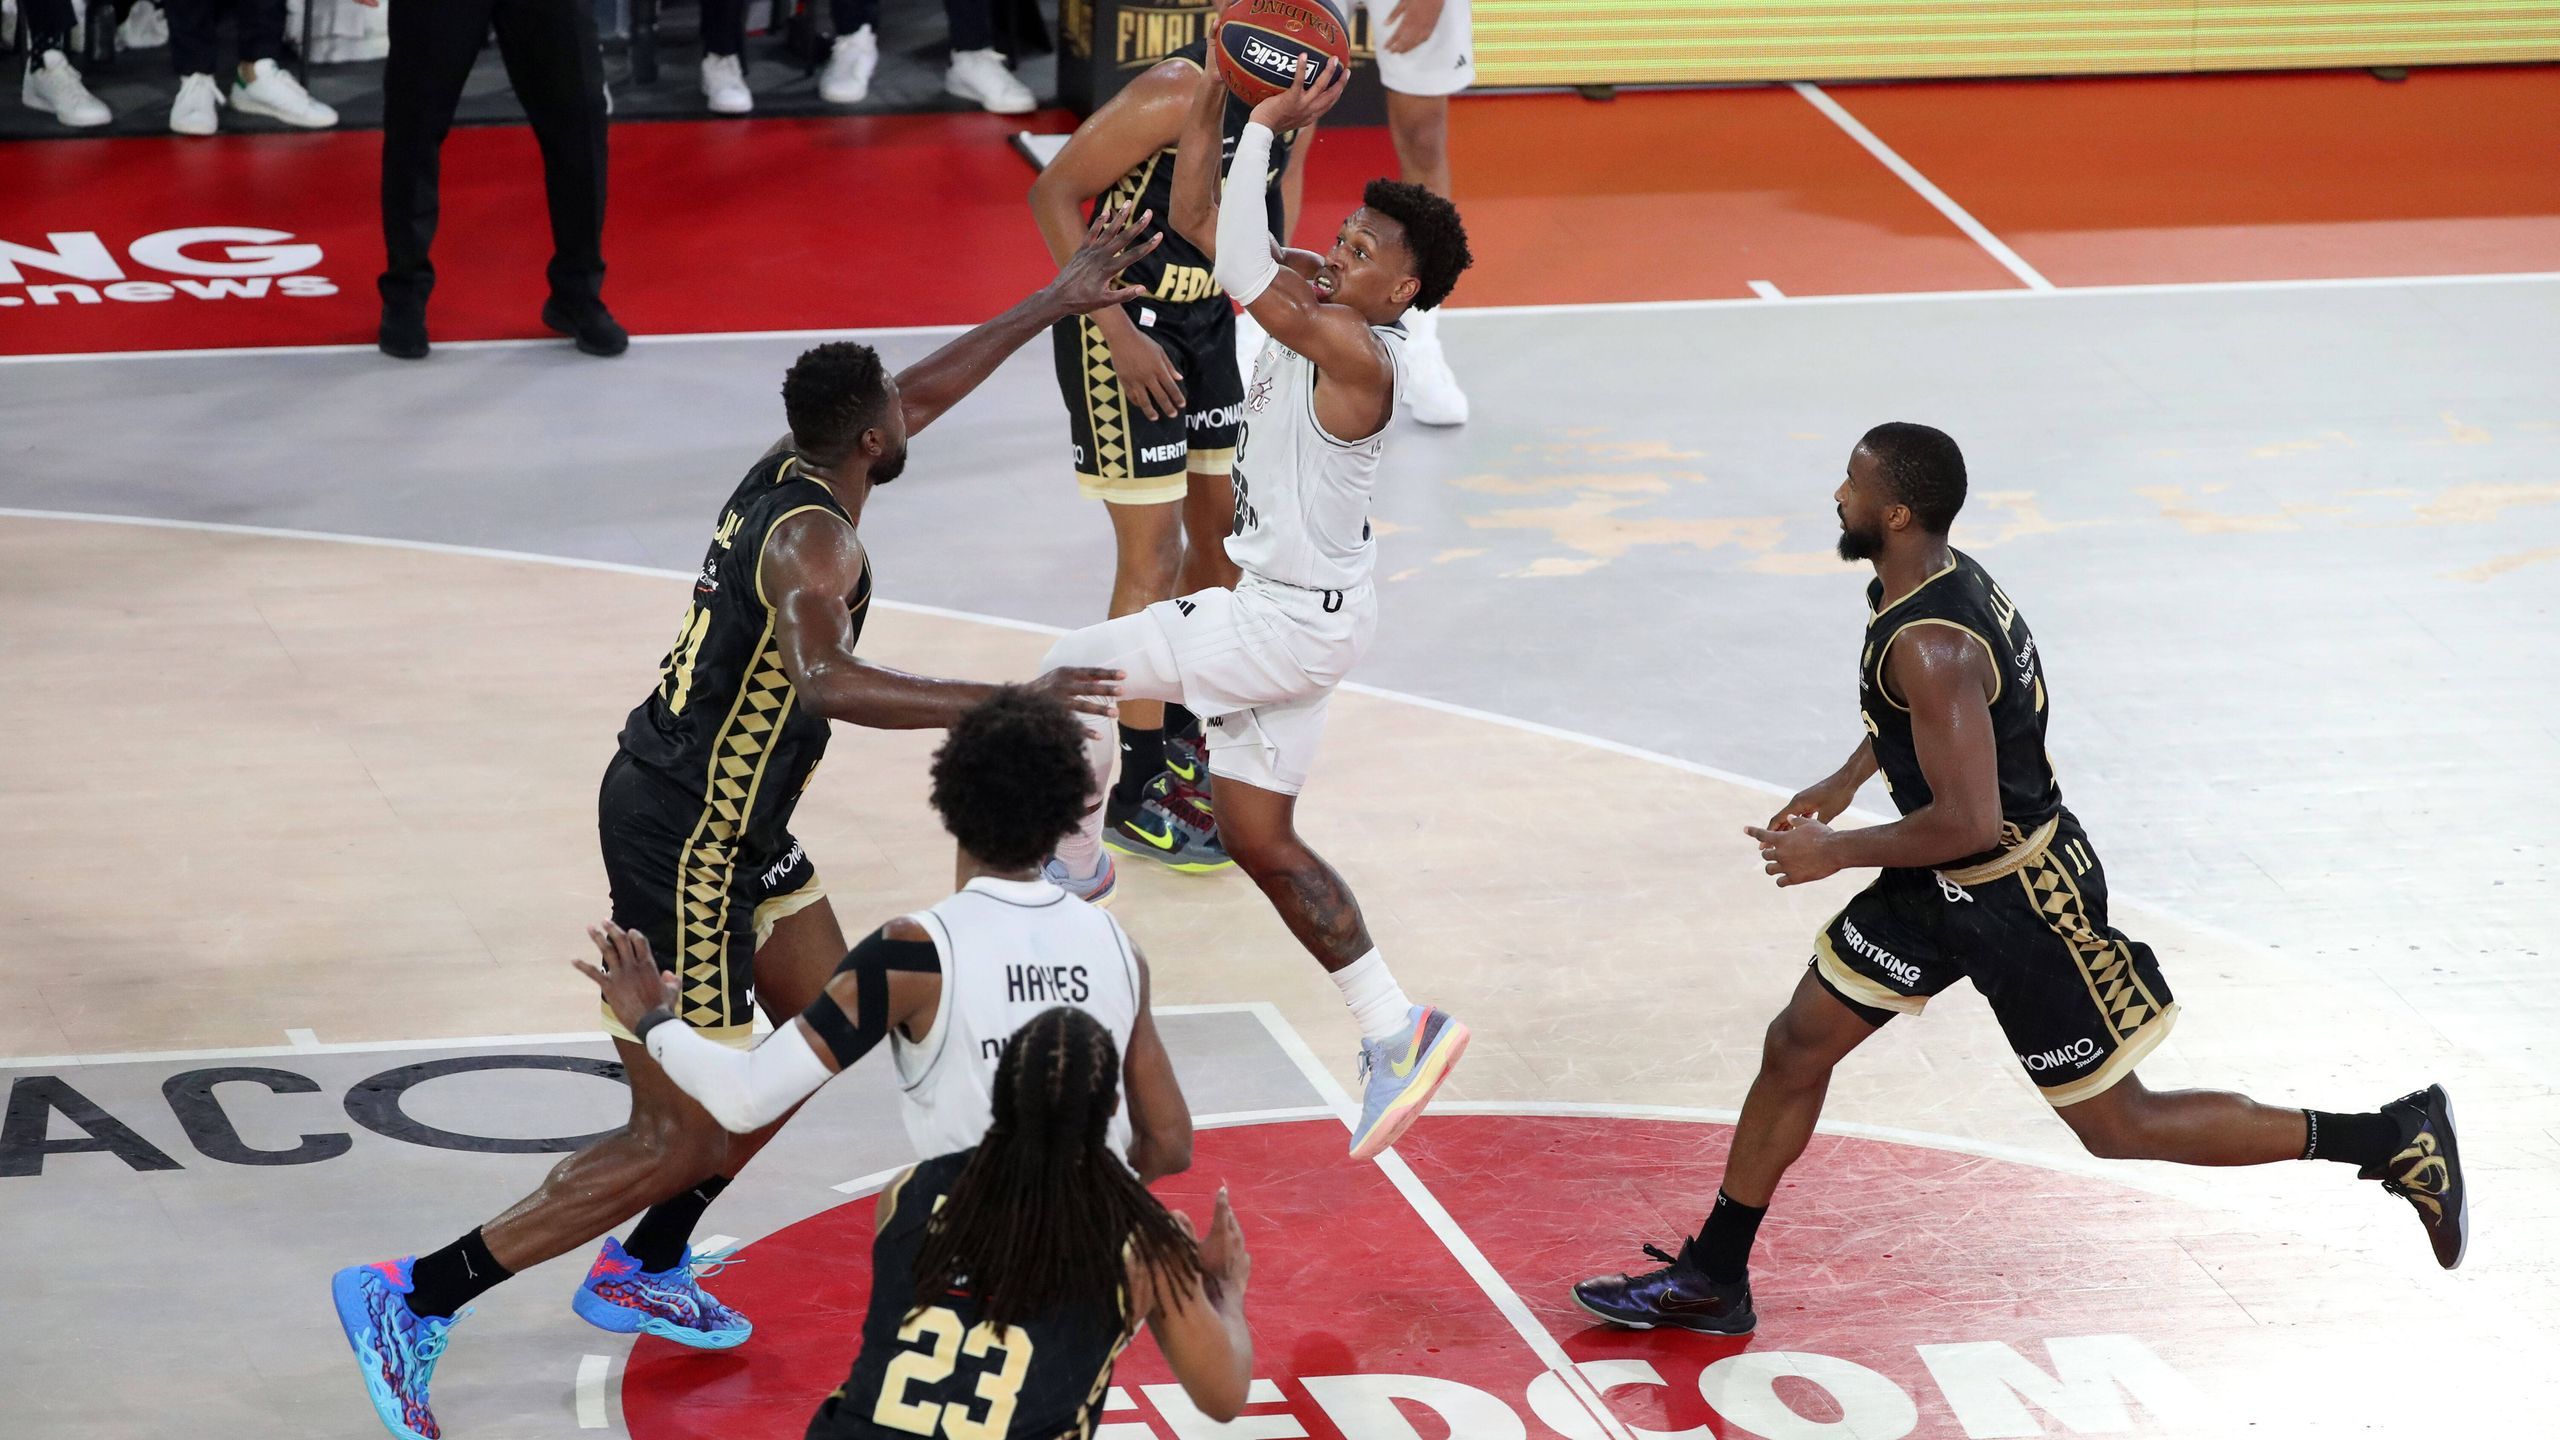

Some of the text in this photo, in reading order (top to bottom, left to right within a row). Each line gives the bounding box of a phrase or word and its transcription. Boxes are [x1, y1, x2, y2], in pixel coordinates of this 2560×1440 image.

[1251, 0, 1339, 44] SPALDING
[1322, 590, 1343, 613] 0
[2065, 838, 2094, 876] 11
[1006, 964, 1090, 1003] HAYES
[2074, 1046, 2105, 1070] SPALDING
[873, 1306, 1034, 1440] 23
